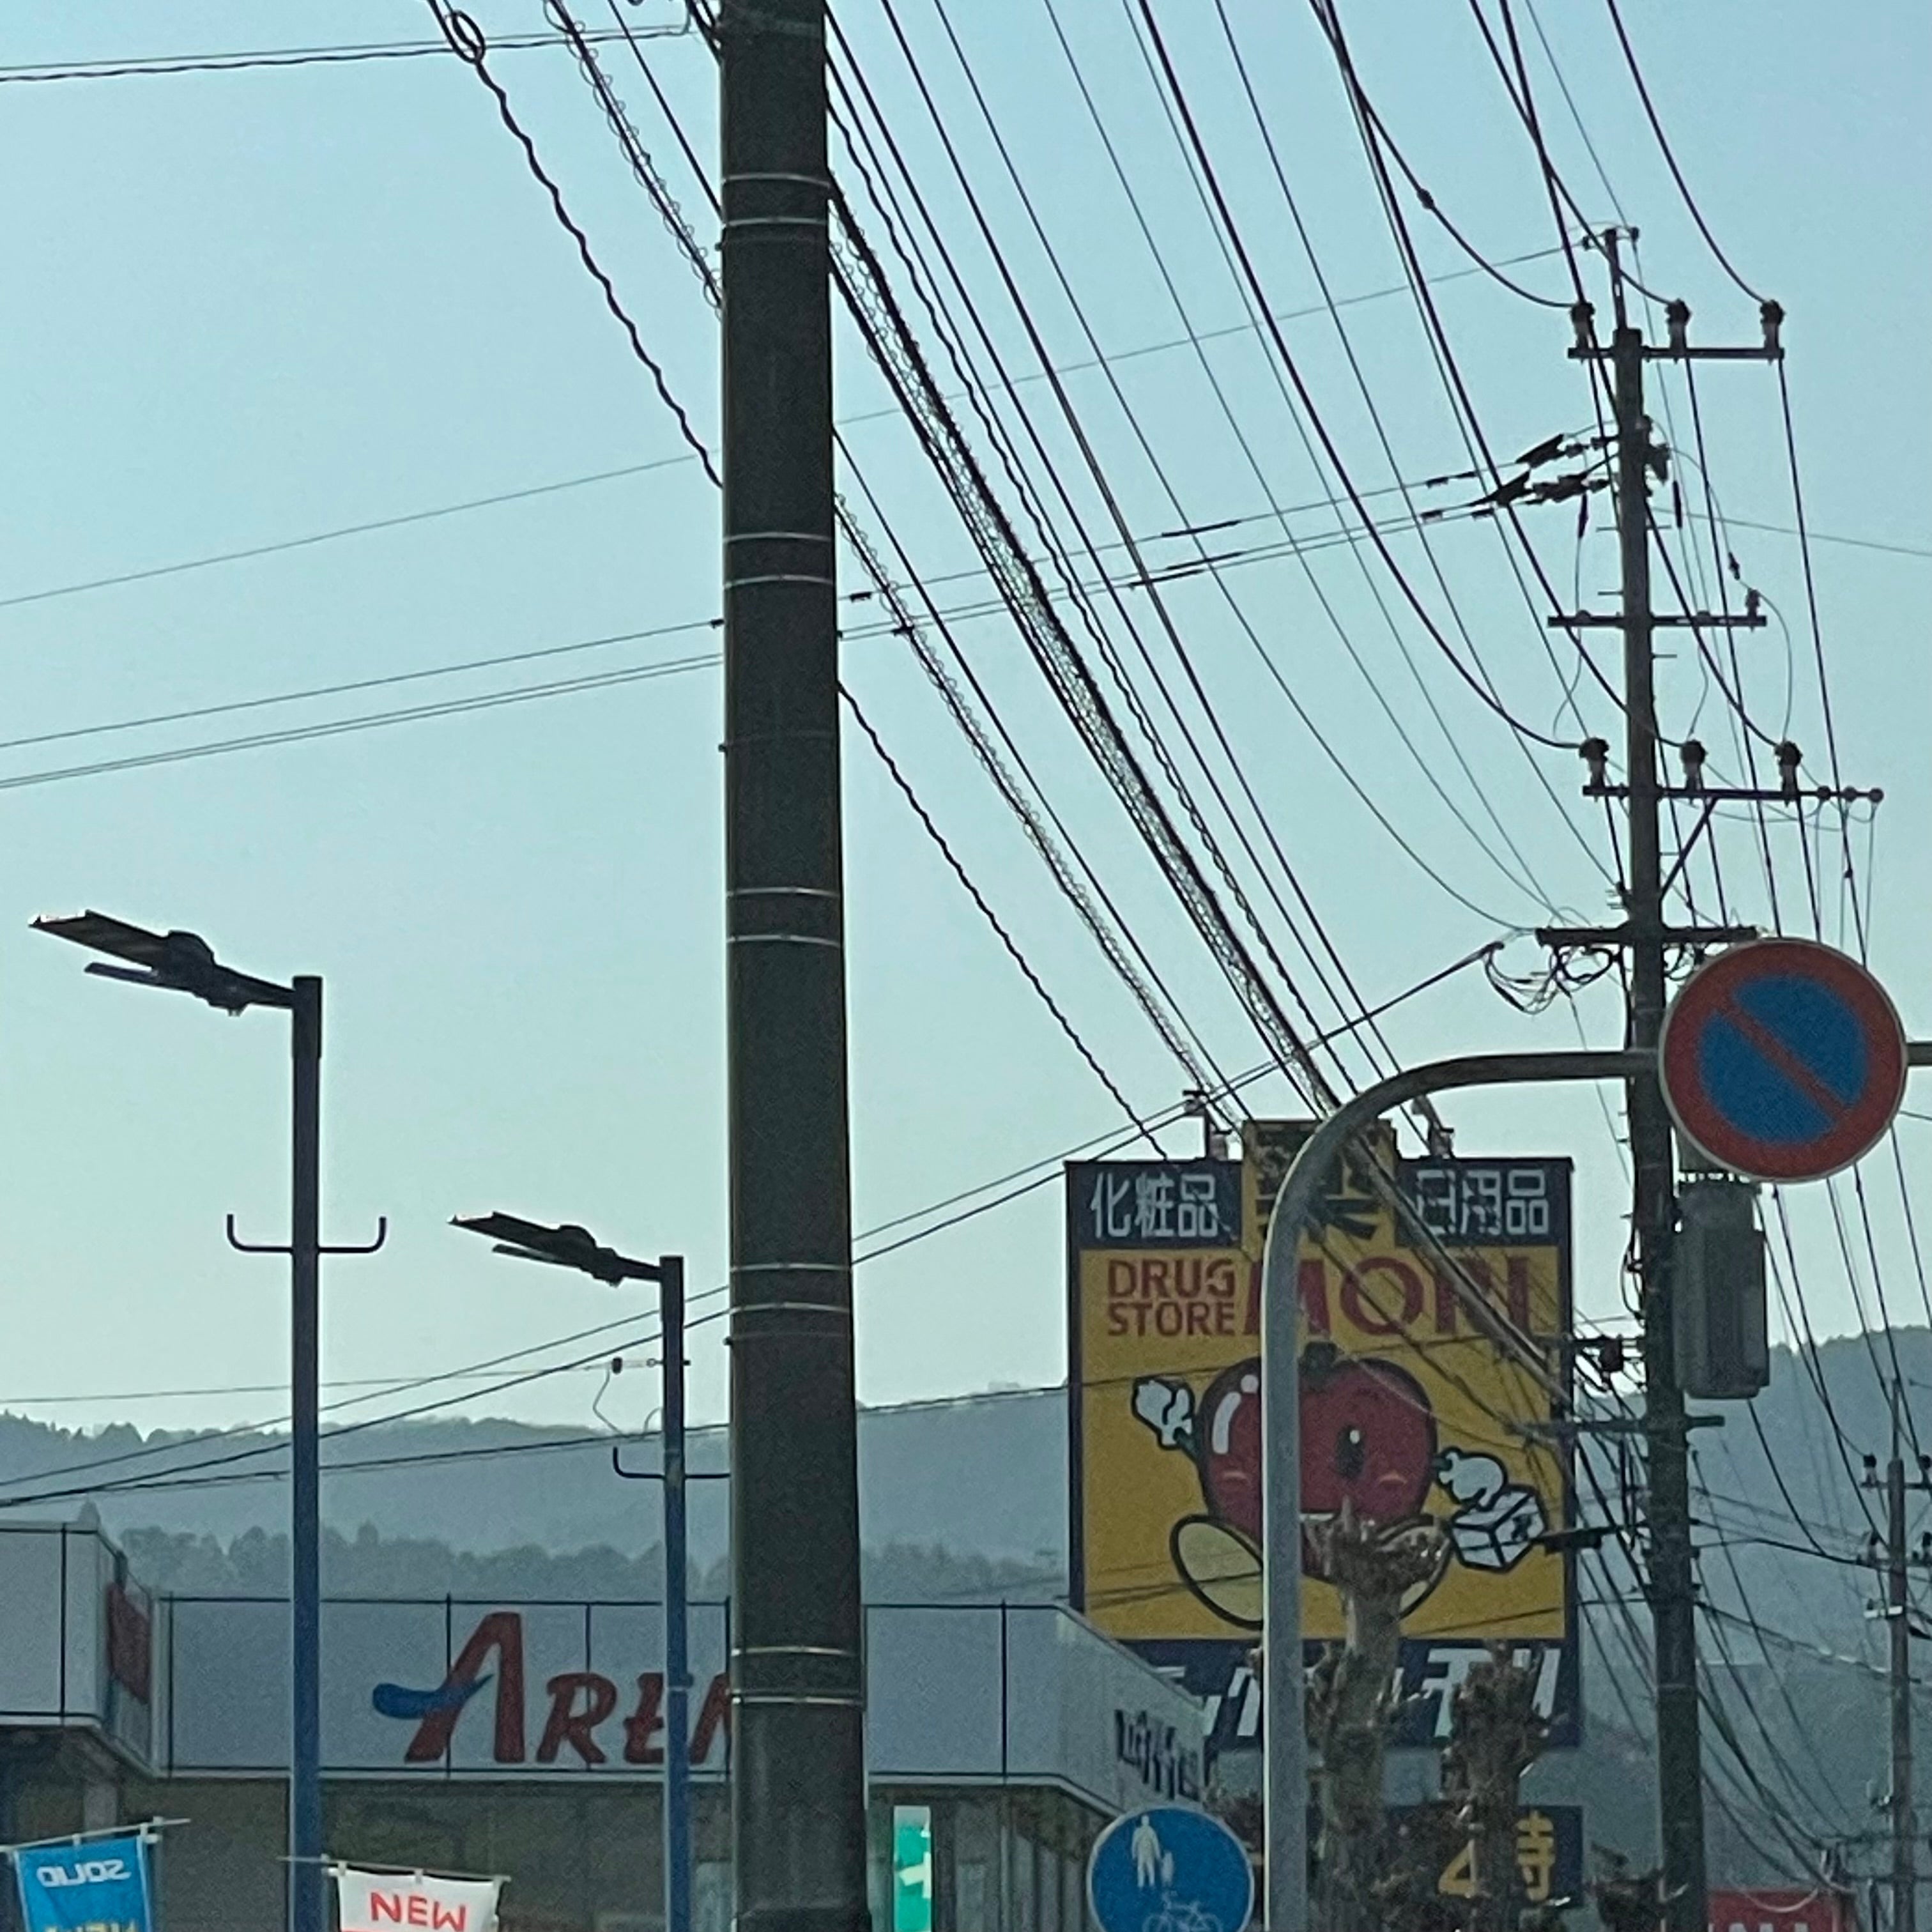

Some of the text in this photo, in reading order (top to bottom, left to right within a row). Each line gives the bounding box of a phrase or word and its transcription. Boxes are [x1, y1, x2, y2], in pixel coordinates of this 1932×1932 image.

[1091, 1172, 1218, 1238] 化粧品
[1416, 1169, 1549, 1234] 日用品
[1108, 1259, 1236, 1299] DRUG
[1107, 1301, 1236, 1336] STORE
[371, 1892, 466, 1932] NEW
